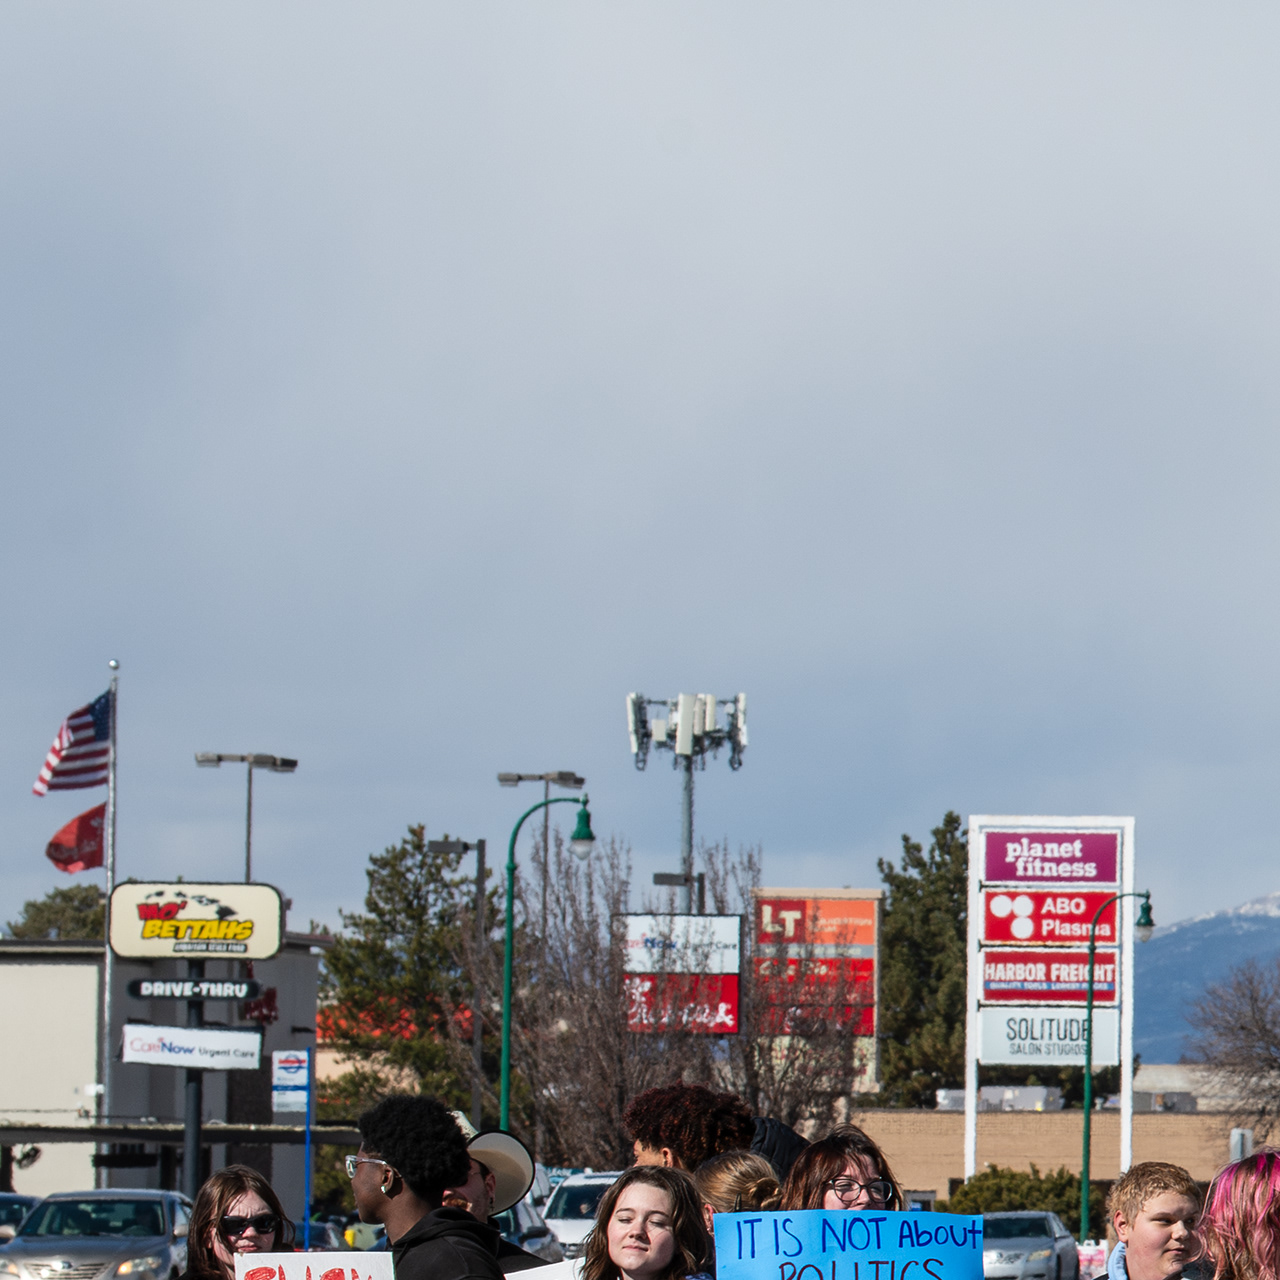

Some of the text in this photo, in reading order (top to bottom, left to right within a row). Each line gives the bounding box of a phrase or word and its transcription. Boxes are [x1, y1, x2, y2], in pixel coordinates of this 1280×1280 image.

[1005, 838, 1082, 862] planet
[1016, 857, 1097, 877] fitness
[1041, 897, 1086, 914] ABO
[142, 919, 253, 941] BETTAHS
[1042, 919, 1111, 936] Plasma
[984, 963, 1046, 980] HARBOR
[141, 981, 248, 998] DRIVE-THRU
[1007, 1018, 1089, 1041] SOLITUDE
[1009, 1043, 1088, 1056] SALON STUDIOS
[737, 1218, 762, 1259] IT
[773, 1218, 803, 1257] IS
[822, 1217, 887, 1252] NOT
